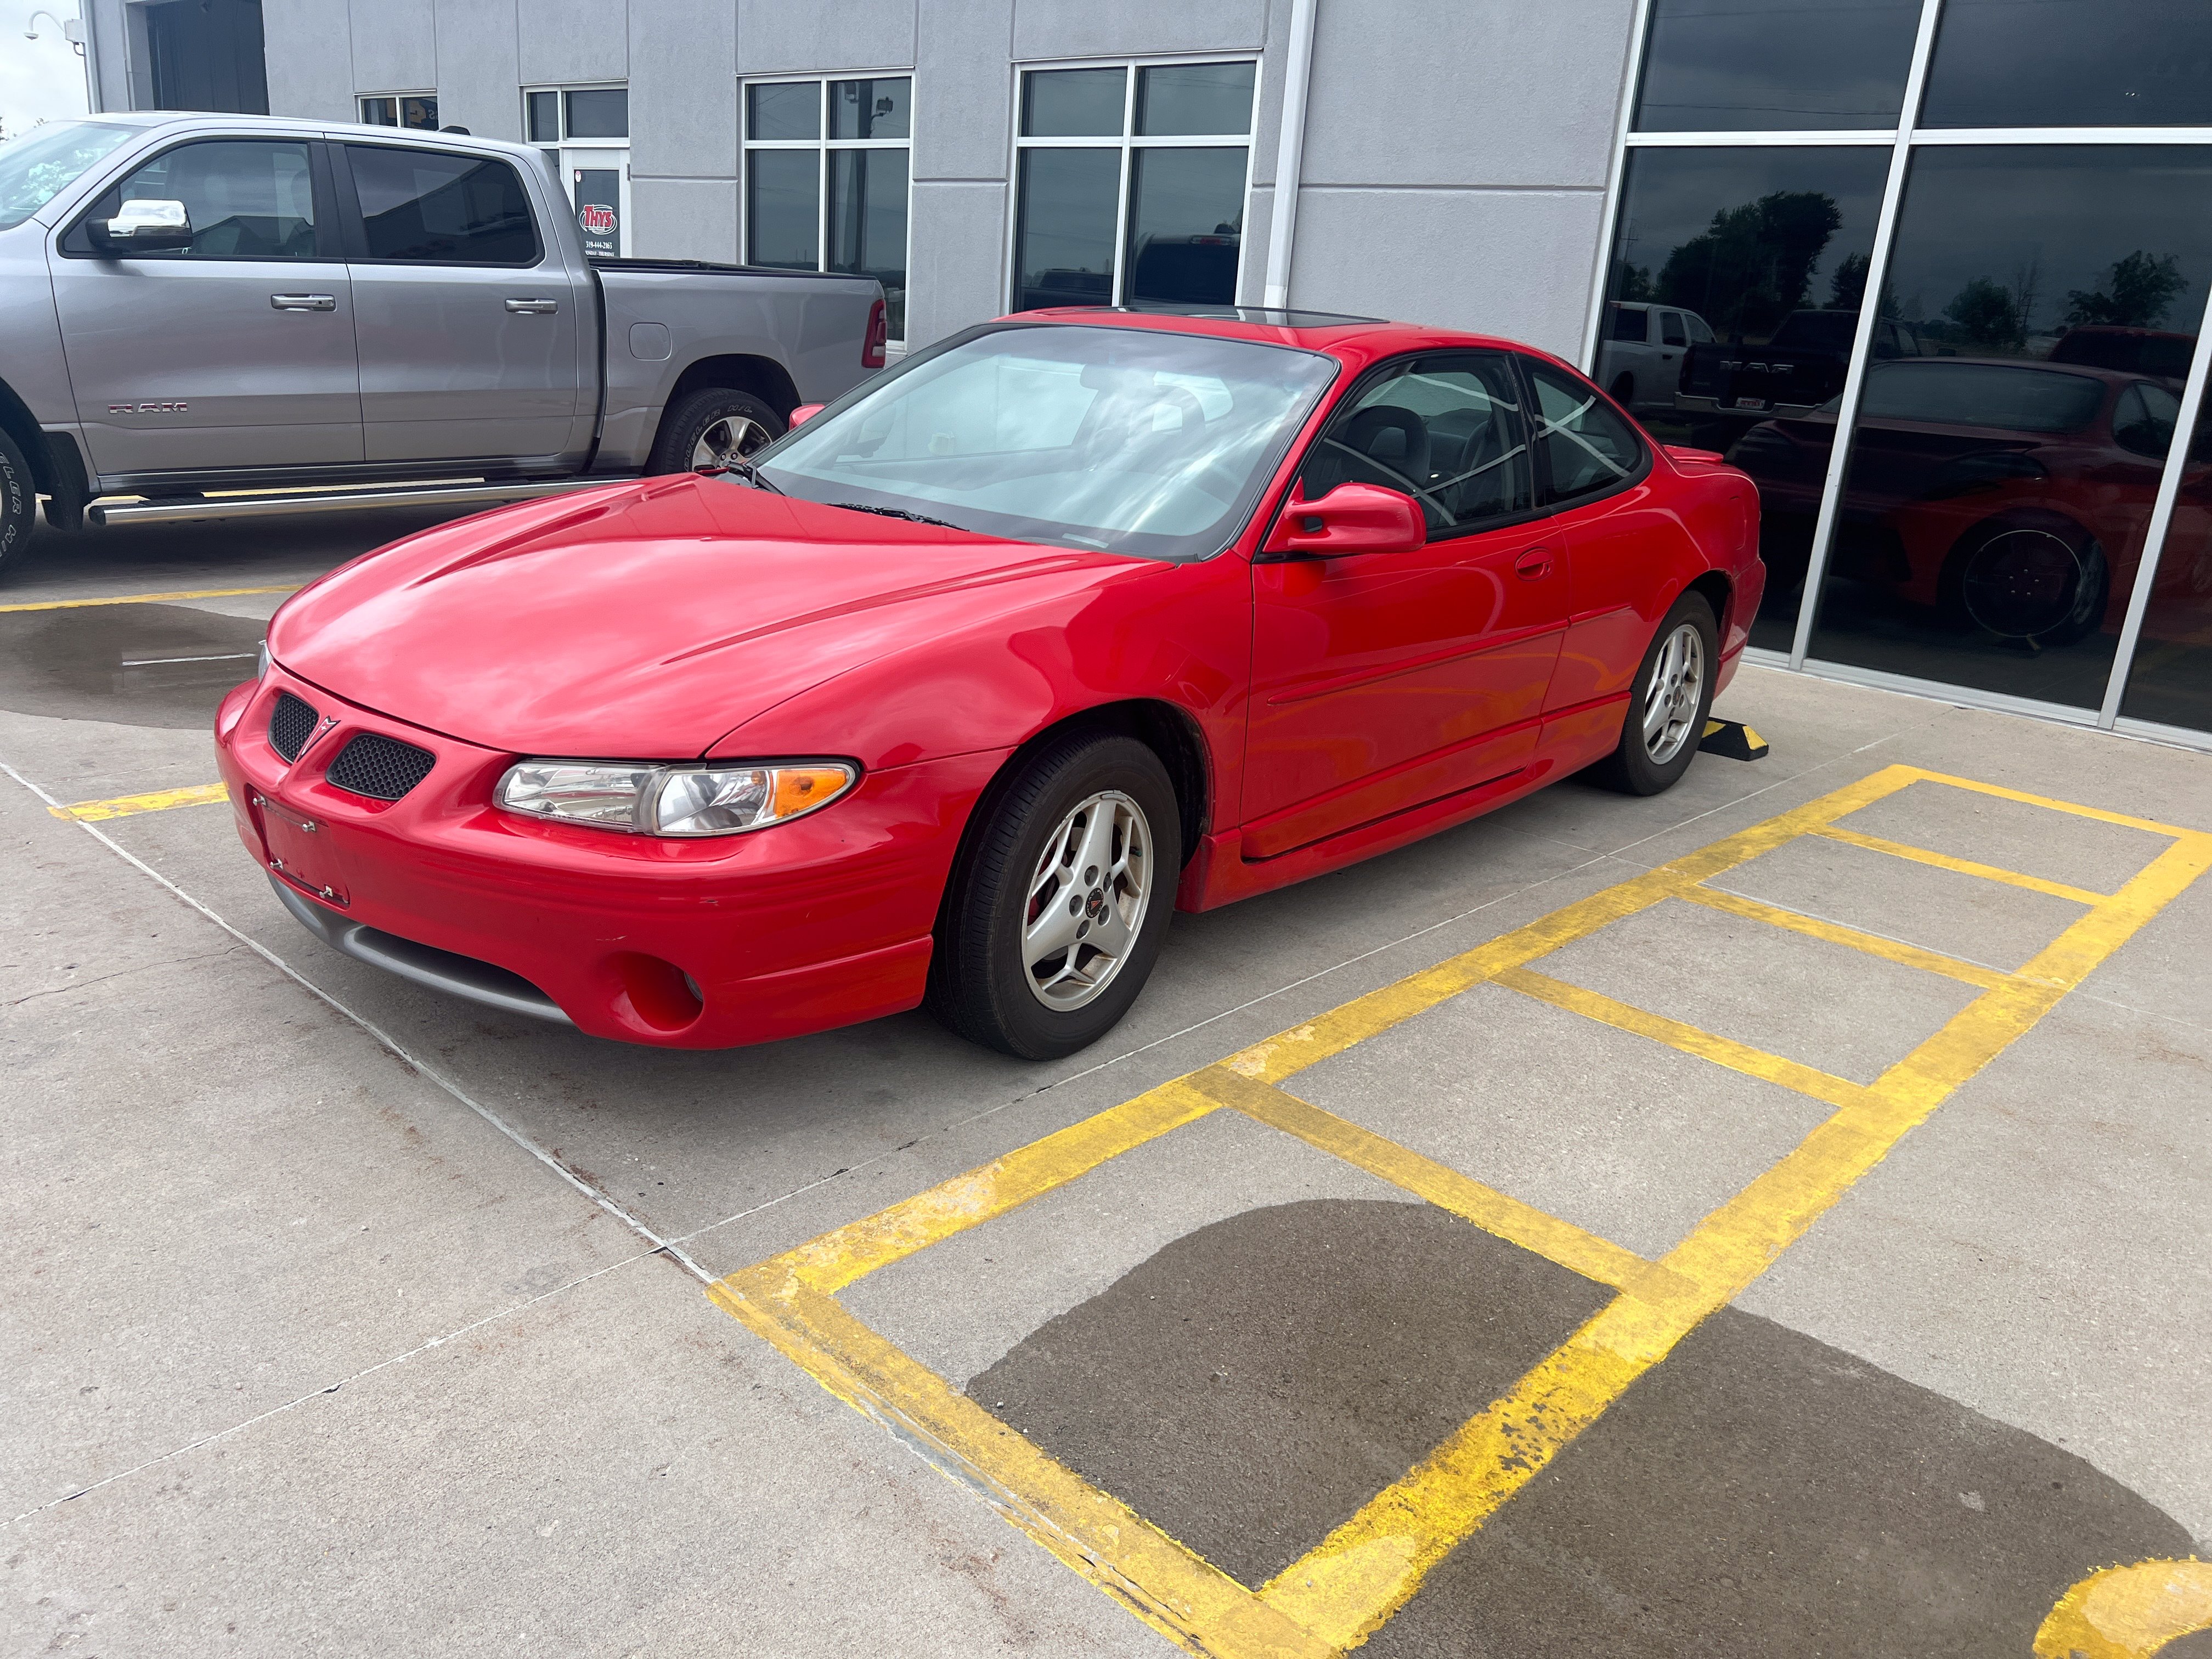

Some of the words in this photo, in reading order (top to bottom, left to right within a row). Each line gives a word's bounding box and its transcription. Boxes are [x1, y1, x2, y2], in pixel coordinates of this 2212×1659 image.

[584, 205, 612, 228] THYS
[586, 241, 613, 249] 319-444-2163
[108, 402, 188, 414] RAM
